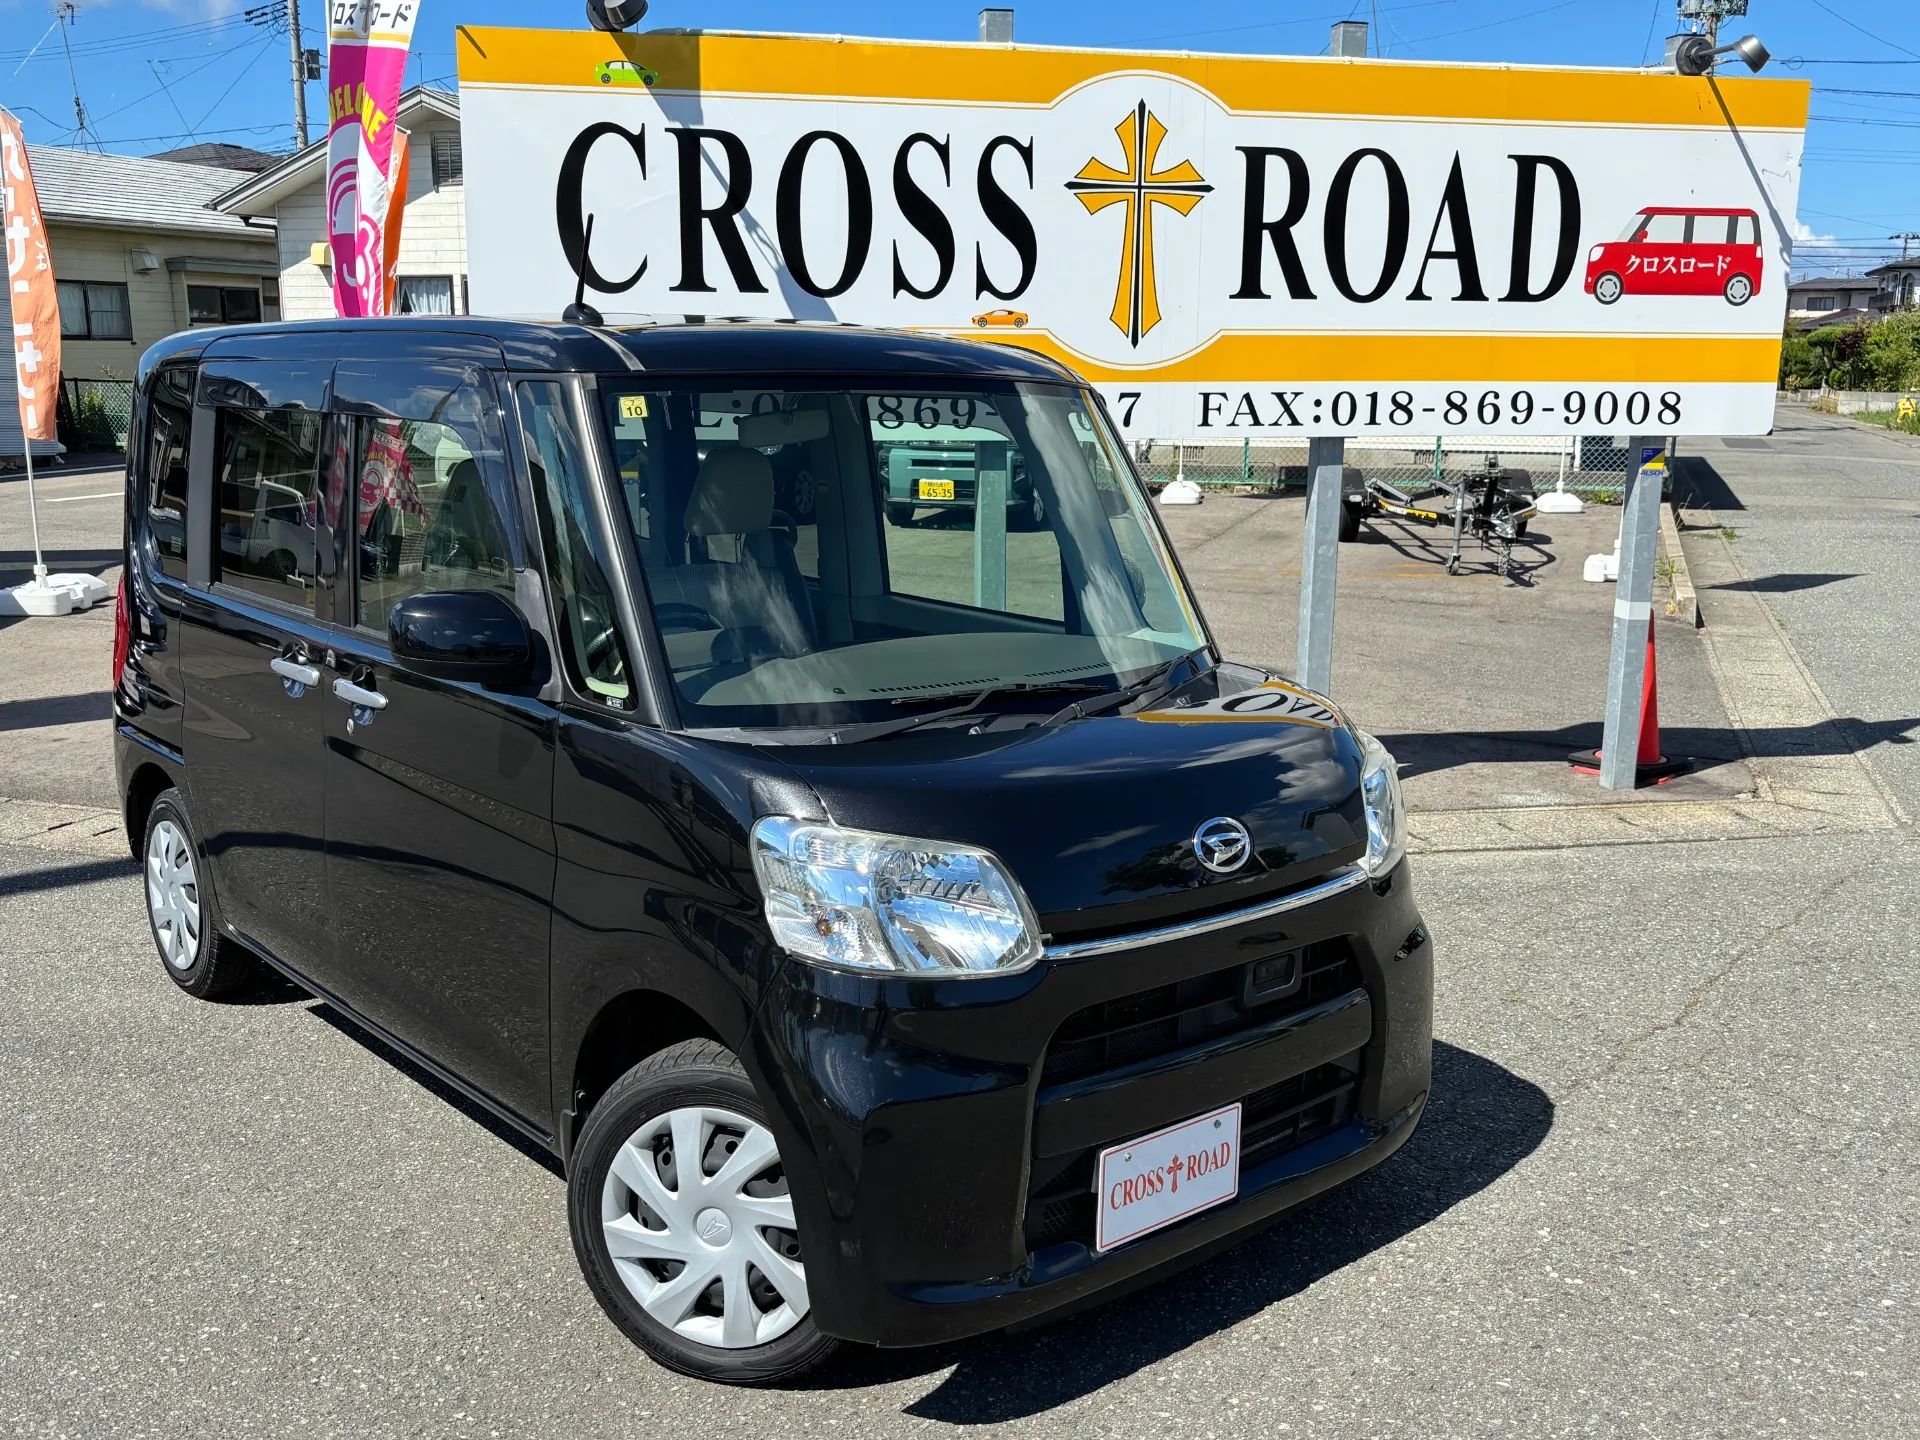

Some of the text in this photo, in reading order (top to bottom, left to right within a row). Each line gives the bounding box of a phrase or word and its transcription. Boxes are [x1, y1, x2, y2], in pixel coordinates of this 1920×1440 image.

[331, 2, 358, 26] ロス
[556, 121, 1582, 304] CROSS ROAD
[1625, 253, 1732, 276] クロスロード
[627, 406, 643, 416] 10
[1198, 390, 1684, 427] FAX:018-869-9008
[1111, 1142, 1231, 1210] CROSS ROAD
